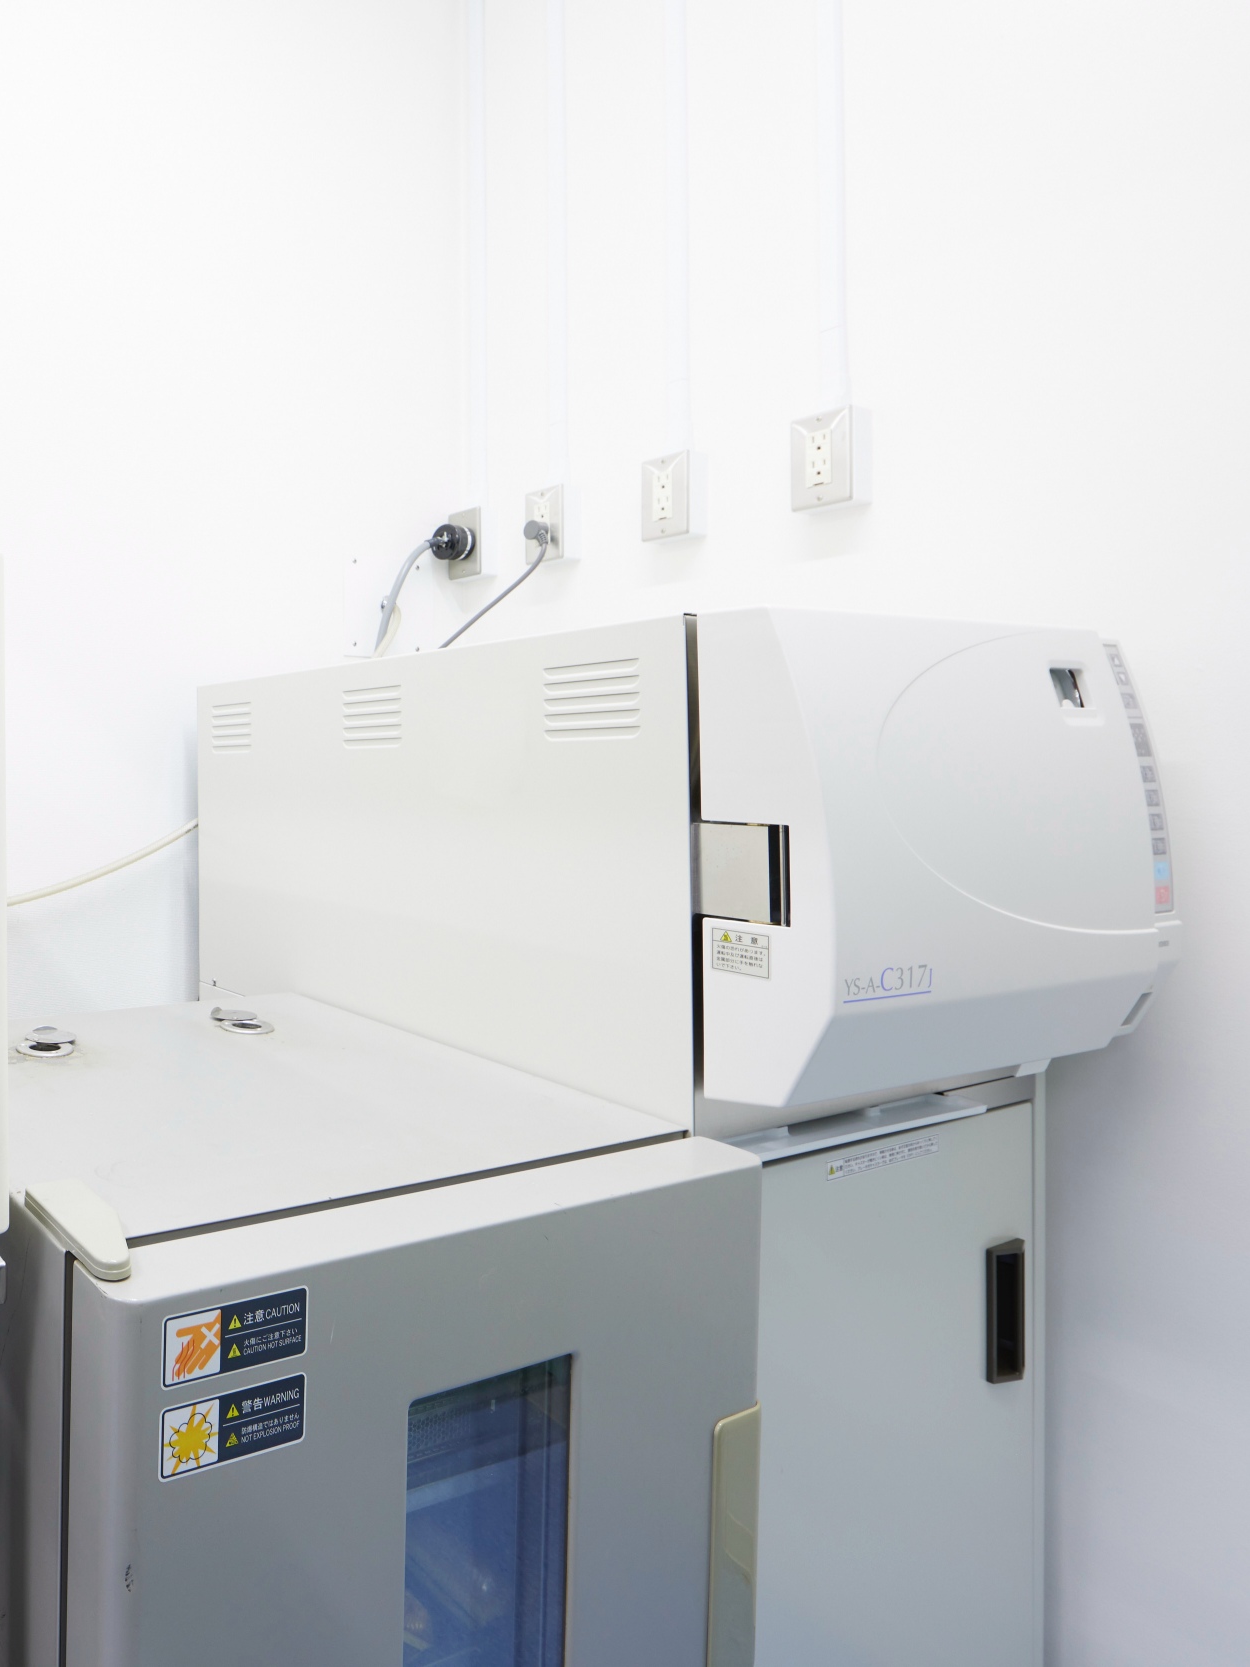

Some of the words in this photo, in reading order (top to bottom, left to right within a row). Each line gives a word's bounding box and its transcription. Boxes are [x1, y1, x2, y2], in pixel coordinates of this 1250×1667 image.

[243, 1343, 267, 1356] CAUTION
[267, 1341, 279, 1351] HOT
[279, 1334, 302, 1347] SURFACE
[241, 1434, 252, 1444] NOT
[253, 1426, 282, 1441] EXPLOSION
[282, 1420, 300, 1431] PROOF
